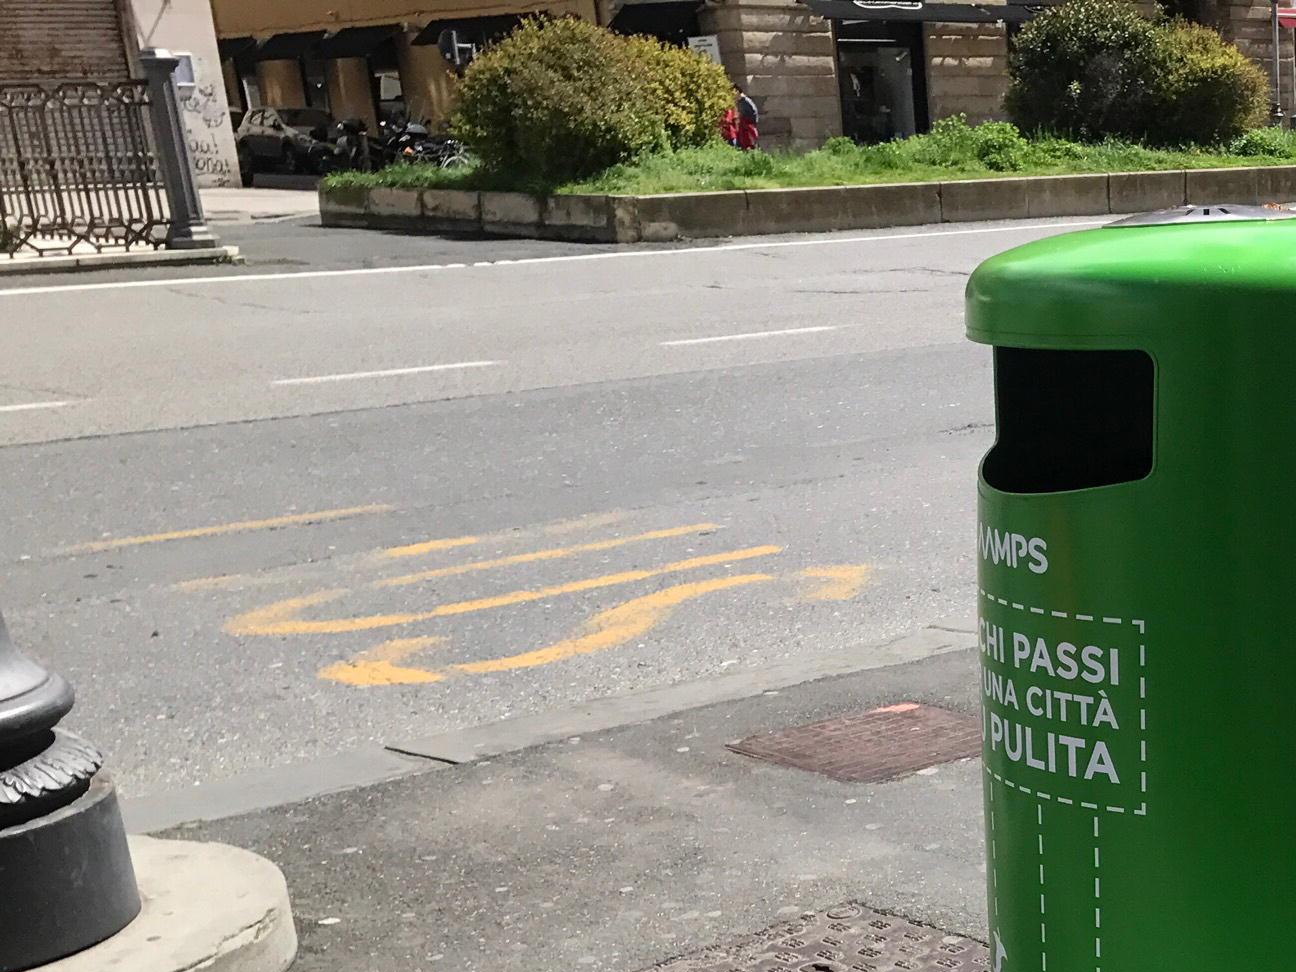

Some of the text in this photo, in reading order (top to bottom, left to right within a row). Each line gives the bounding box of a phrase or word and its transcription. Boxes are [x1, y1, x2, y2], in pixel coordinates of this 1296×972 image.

[1013, 631, 1120, 686] PASSI
[983, 666, 1020, 711] UNA
[1026, 686, 1120, 730] CITTÀ
[990, 711, 1121, 784] PULITA
